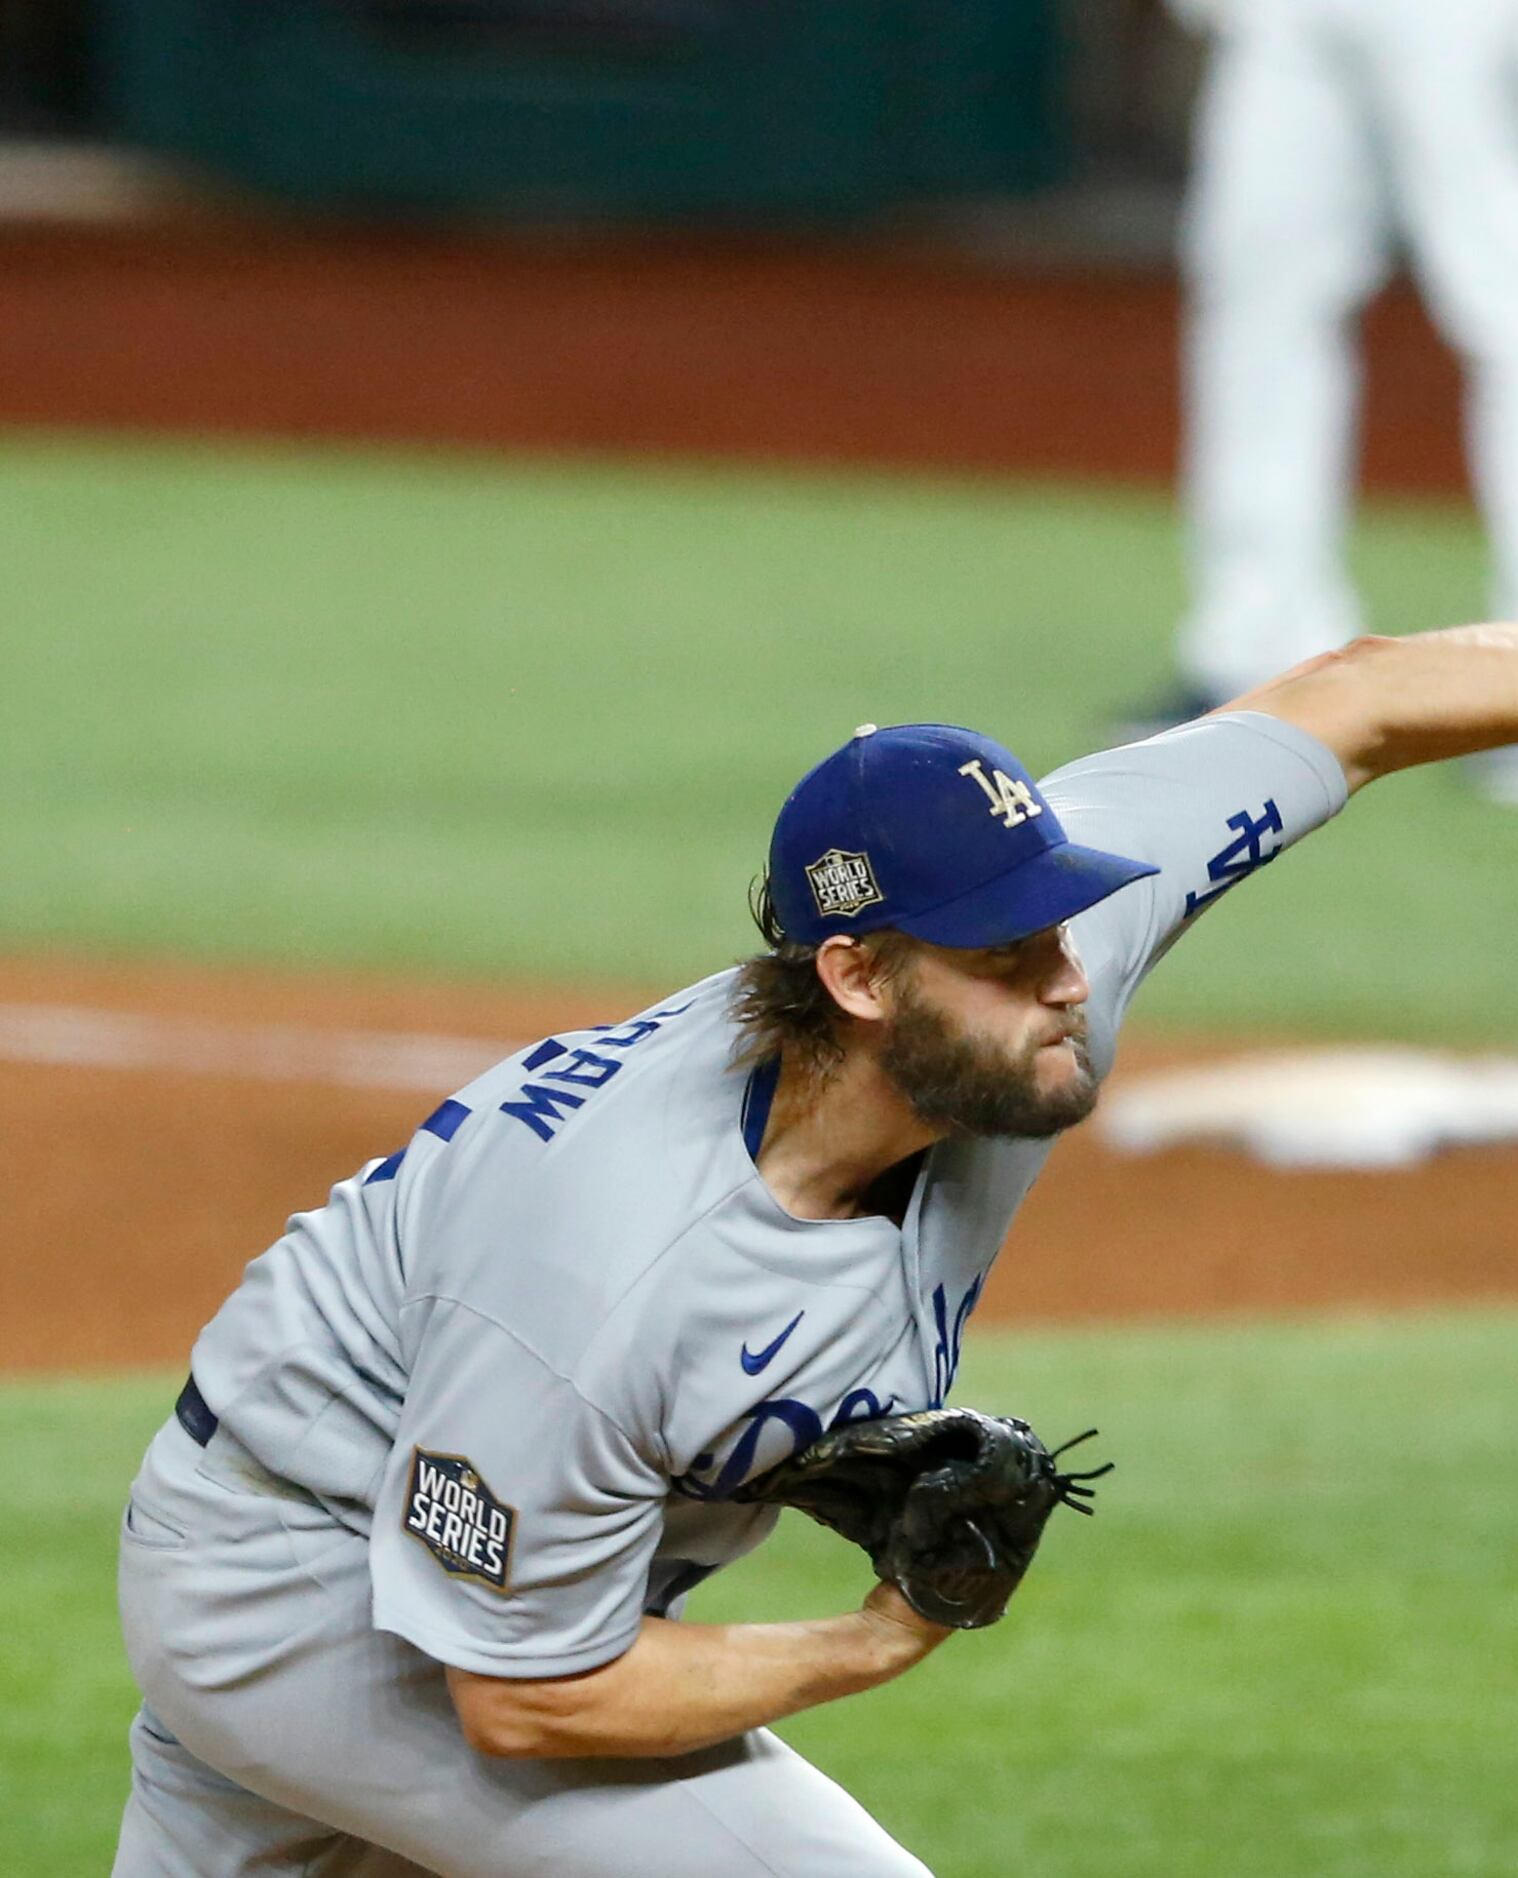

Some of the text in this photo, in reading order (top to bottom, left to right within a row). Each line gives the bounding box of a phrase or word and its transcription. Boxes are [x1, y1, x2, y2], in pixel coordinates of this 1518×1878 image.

[958, 760, 1042, 828] LA
[812, 861, 867, 889] WORLD
[818, 878, 874, 908] SERIES
[408, 1493, 503, 1575] SERIES
[419, 1460, 507, 1543] WORLD
